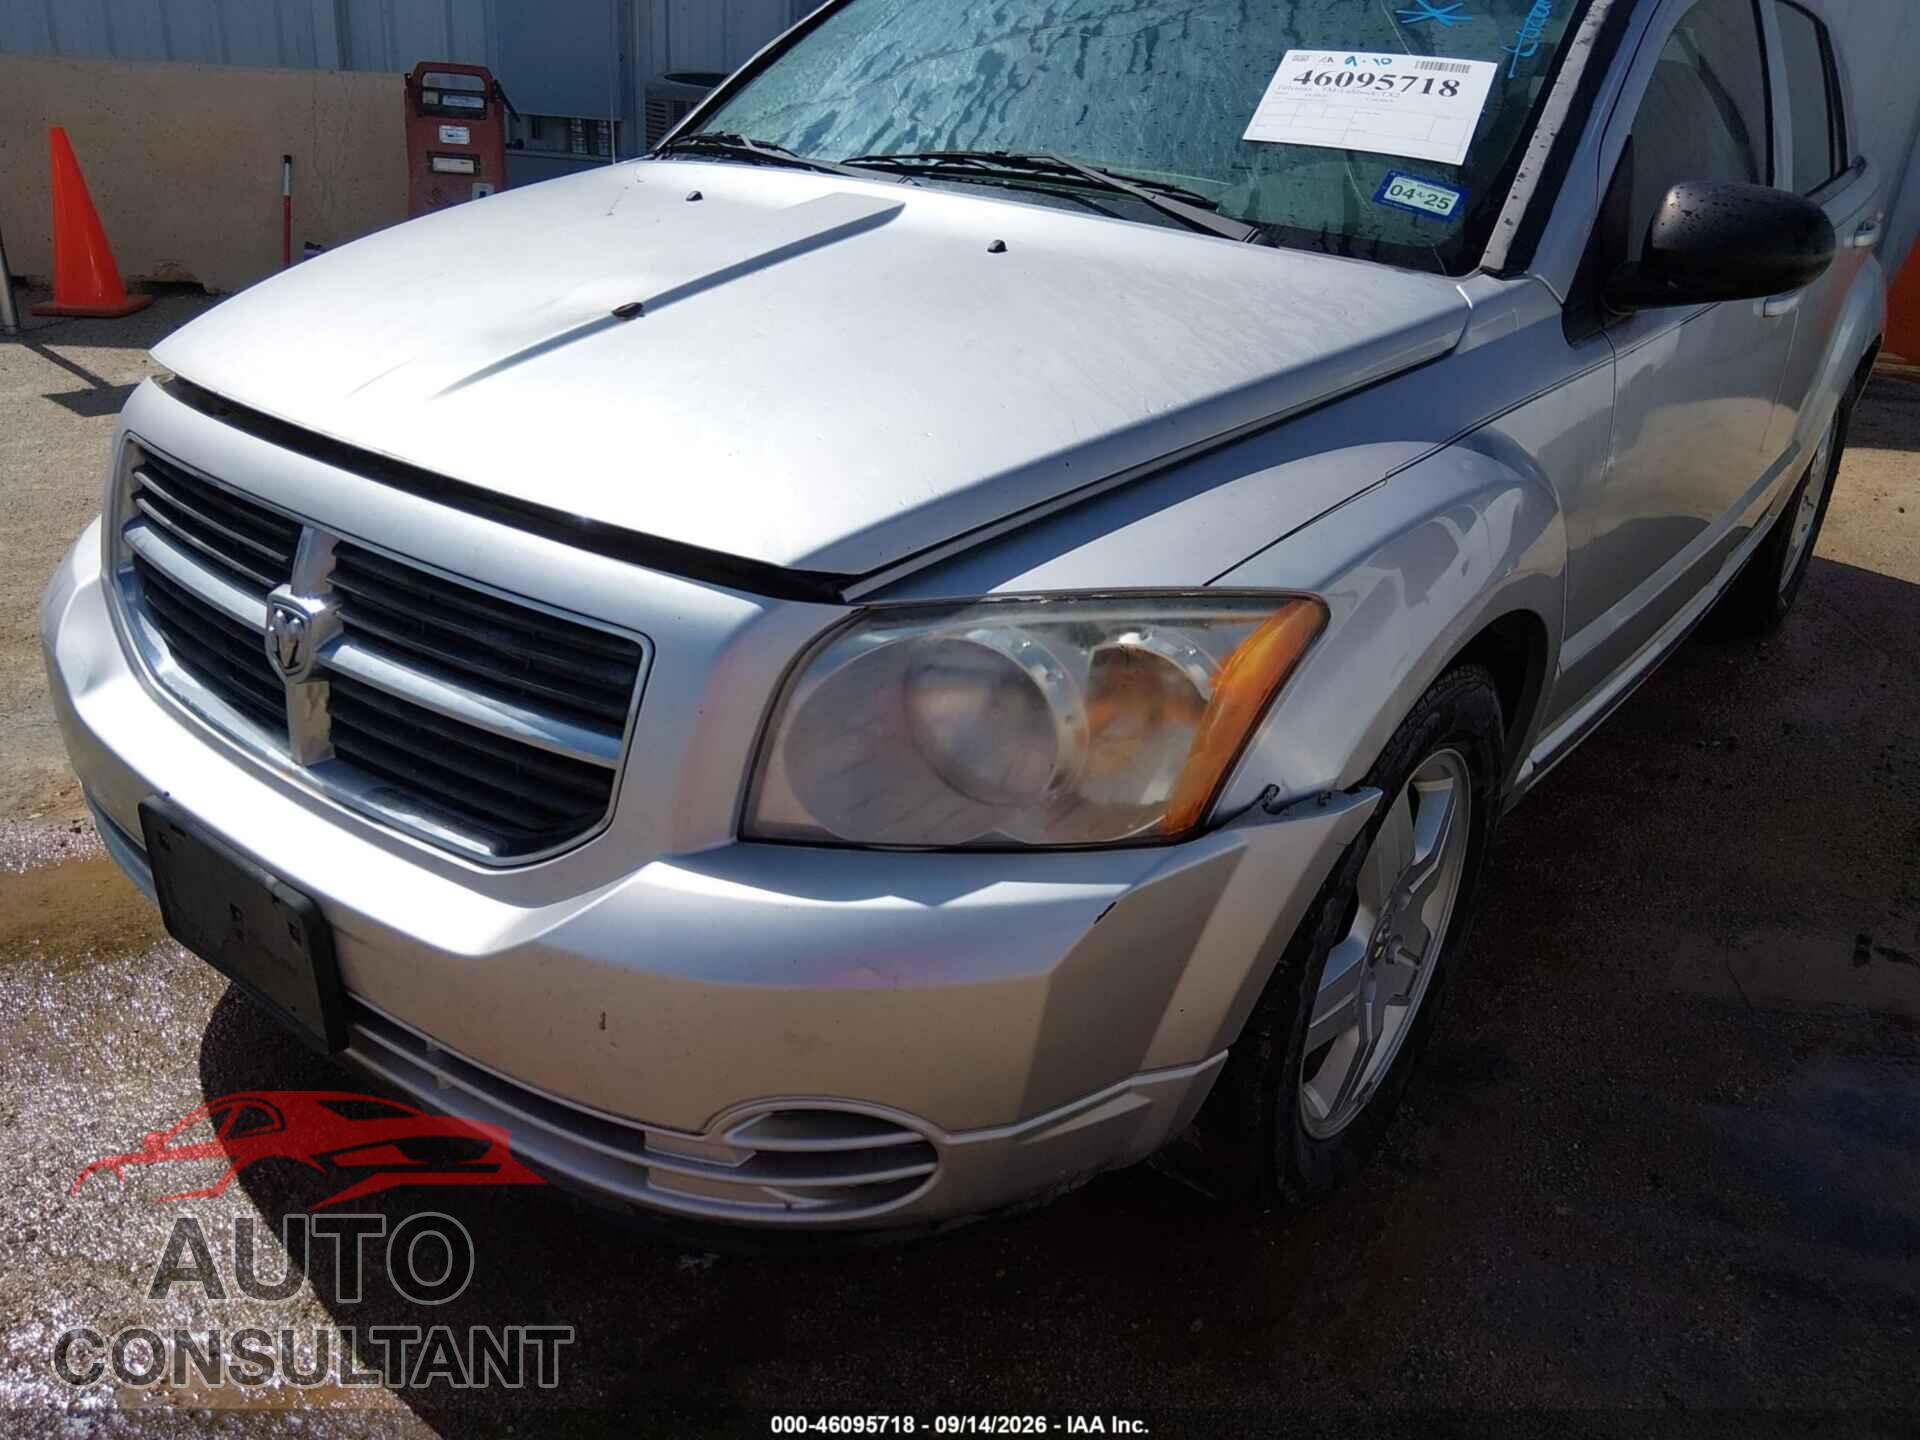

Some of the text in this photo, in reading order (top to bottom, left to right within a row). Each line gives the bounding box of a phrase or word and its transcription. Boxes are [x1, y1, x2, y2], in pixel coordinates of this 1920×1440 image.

[1293, 69, 1461, 98] 46095718
[1390, 184, 1416, 200] 04
[1423, 193, 1452, 210] 25
